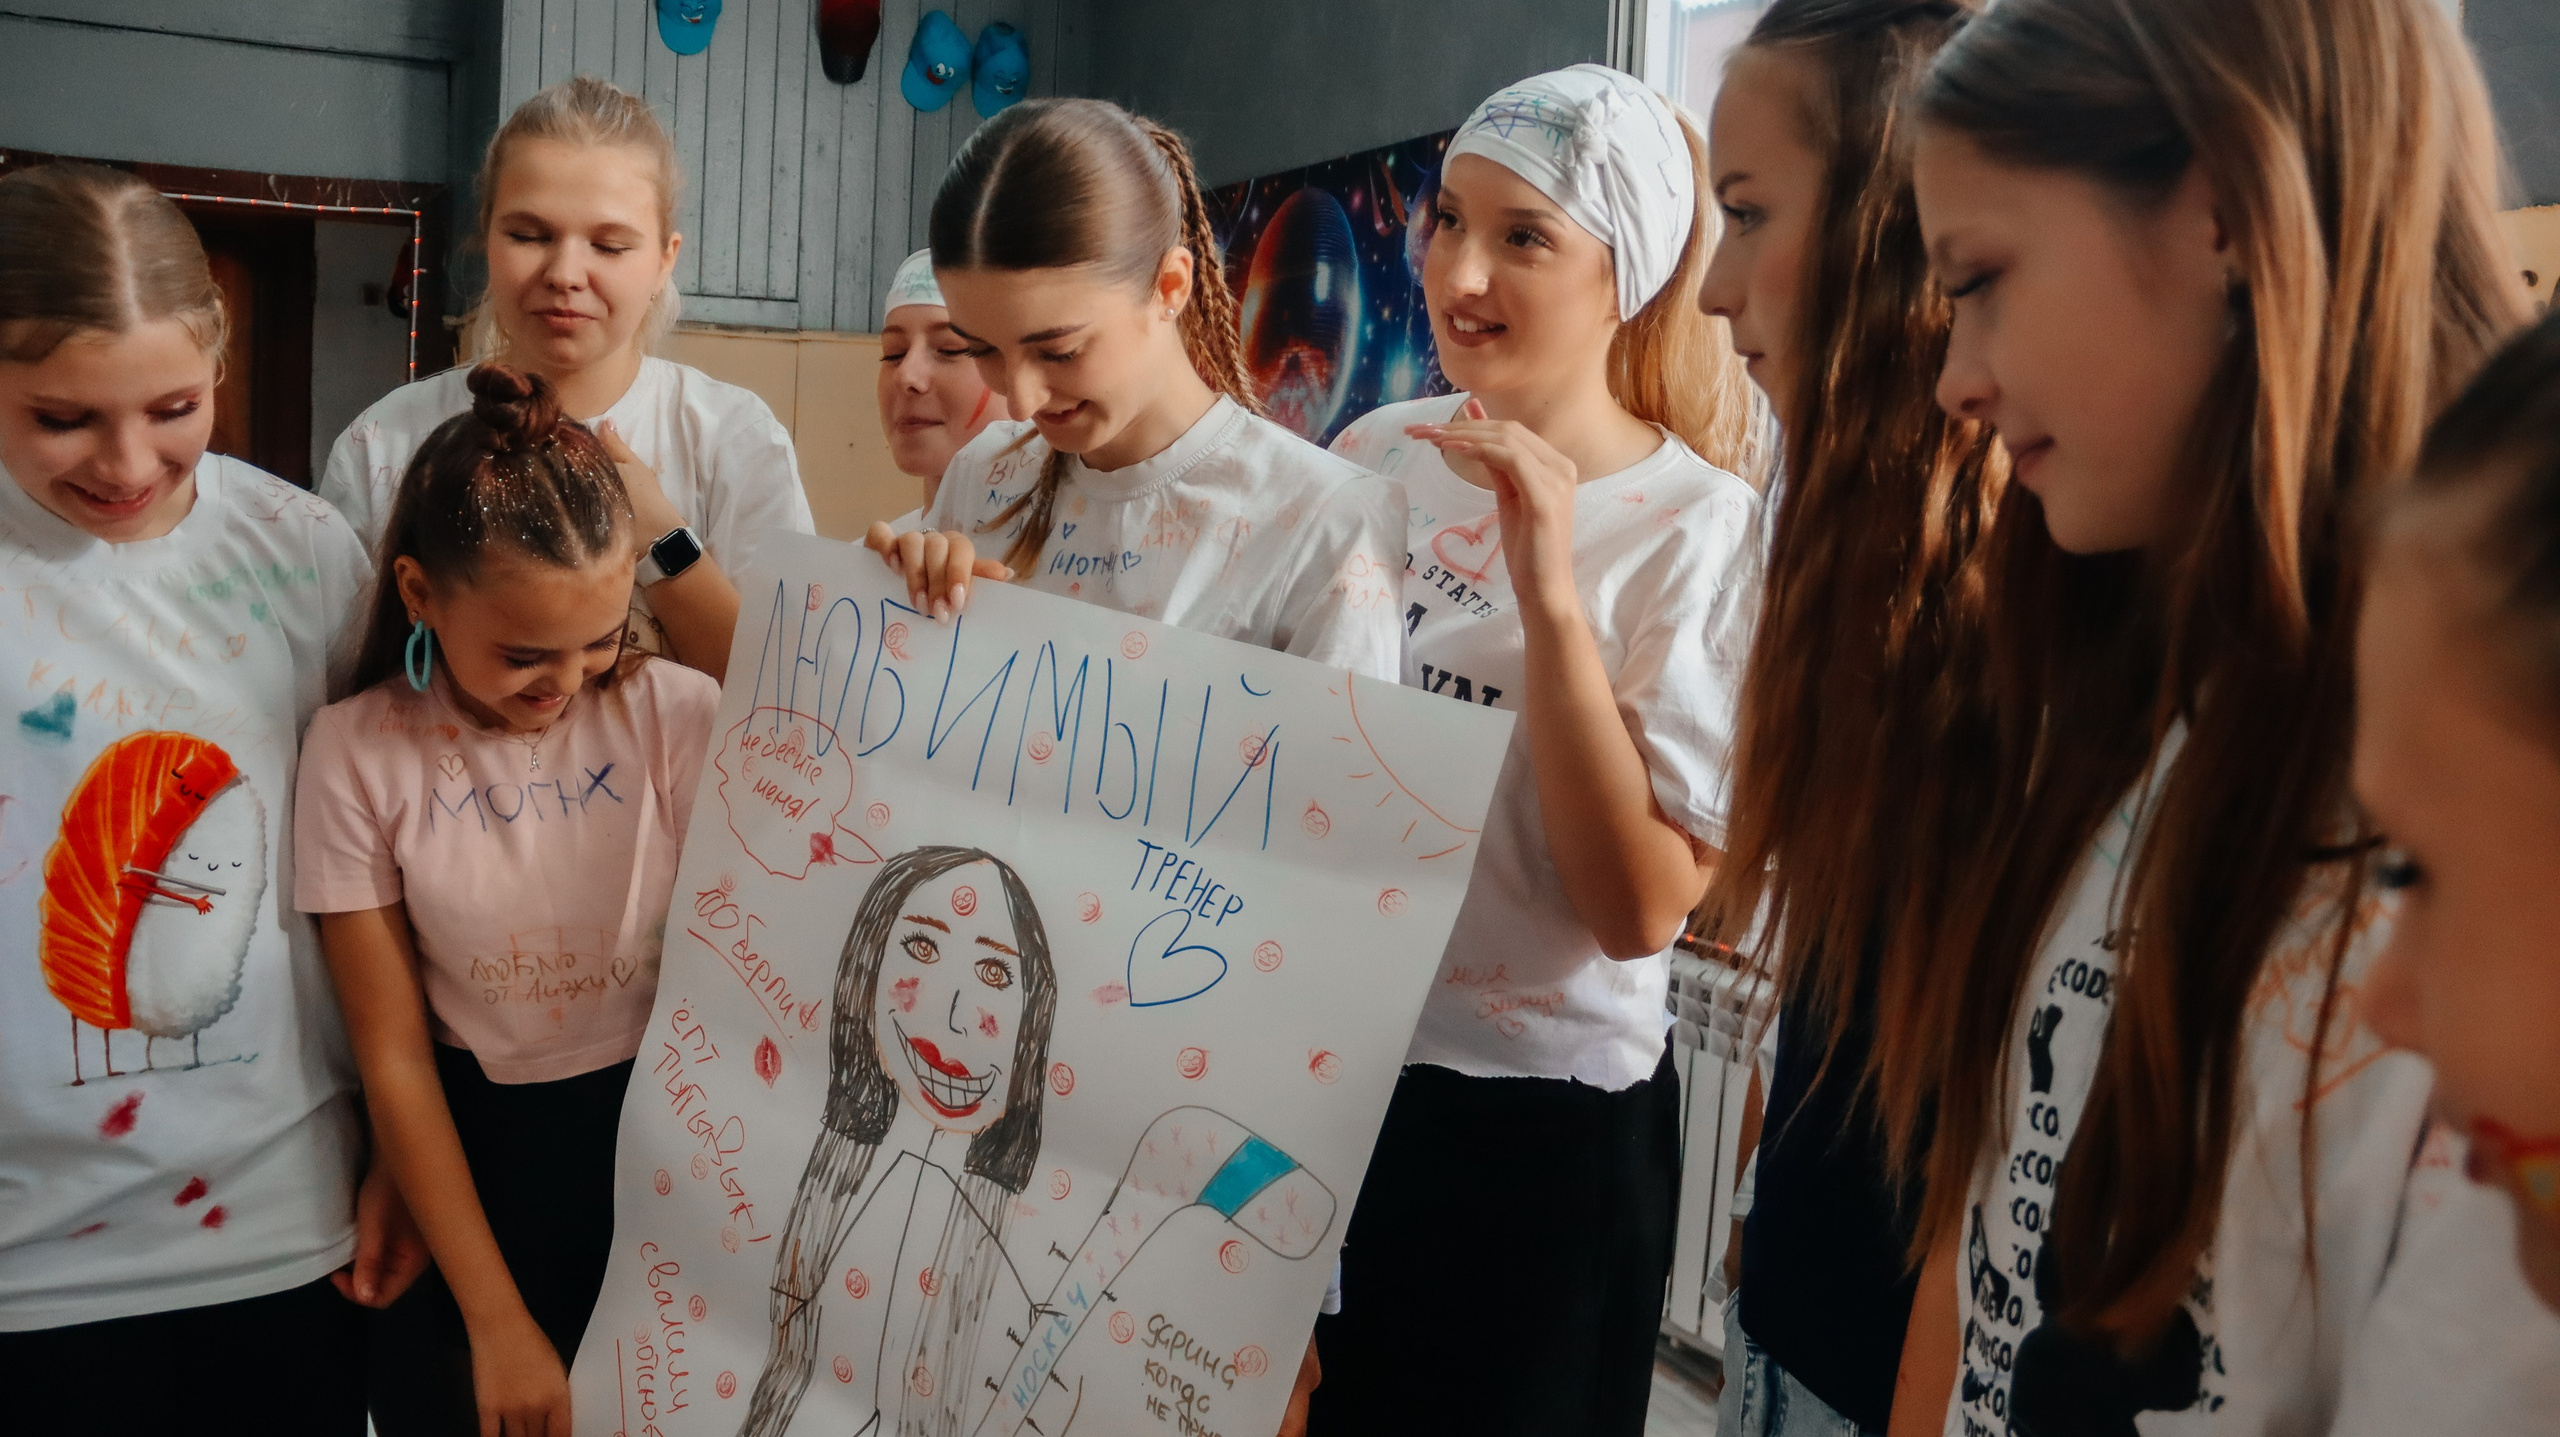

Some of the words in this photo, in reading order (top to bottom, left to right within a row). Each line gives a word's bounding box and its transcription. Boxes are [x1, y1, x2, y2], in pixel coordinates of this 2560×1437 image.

[1422, 564, 1499, 620] STATES
[746, 577, 1280, 851] ЛЮБИМЫЙ
[1130, 838, 1245, 926] ТРЕНЕР
